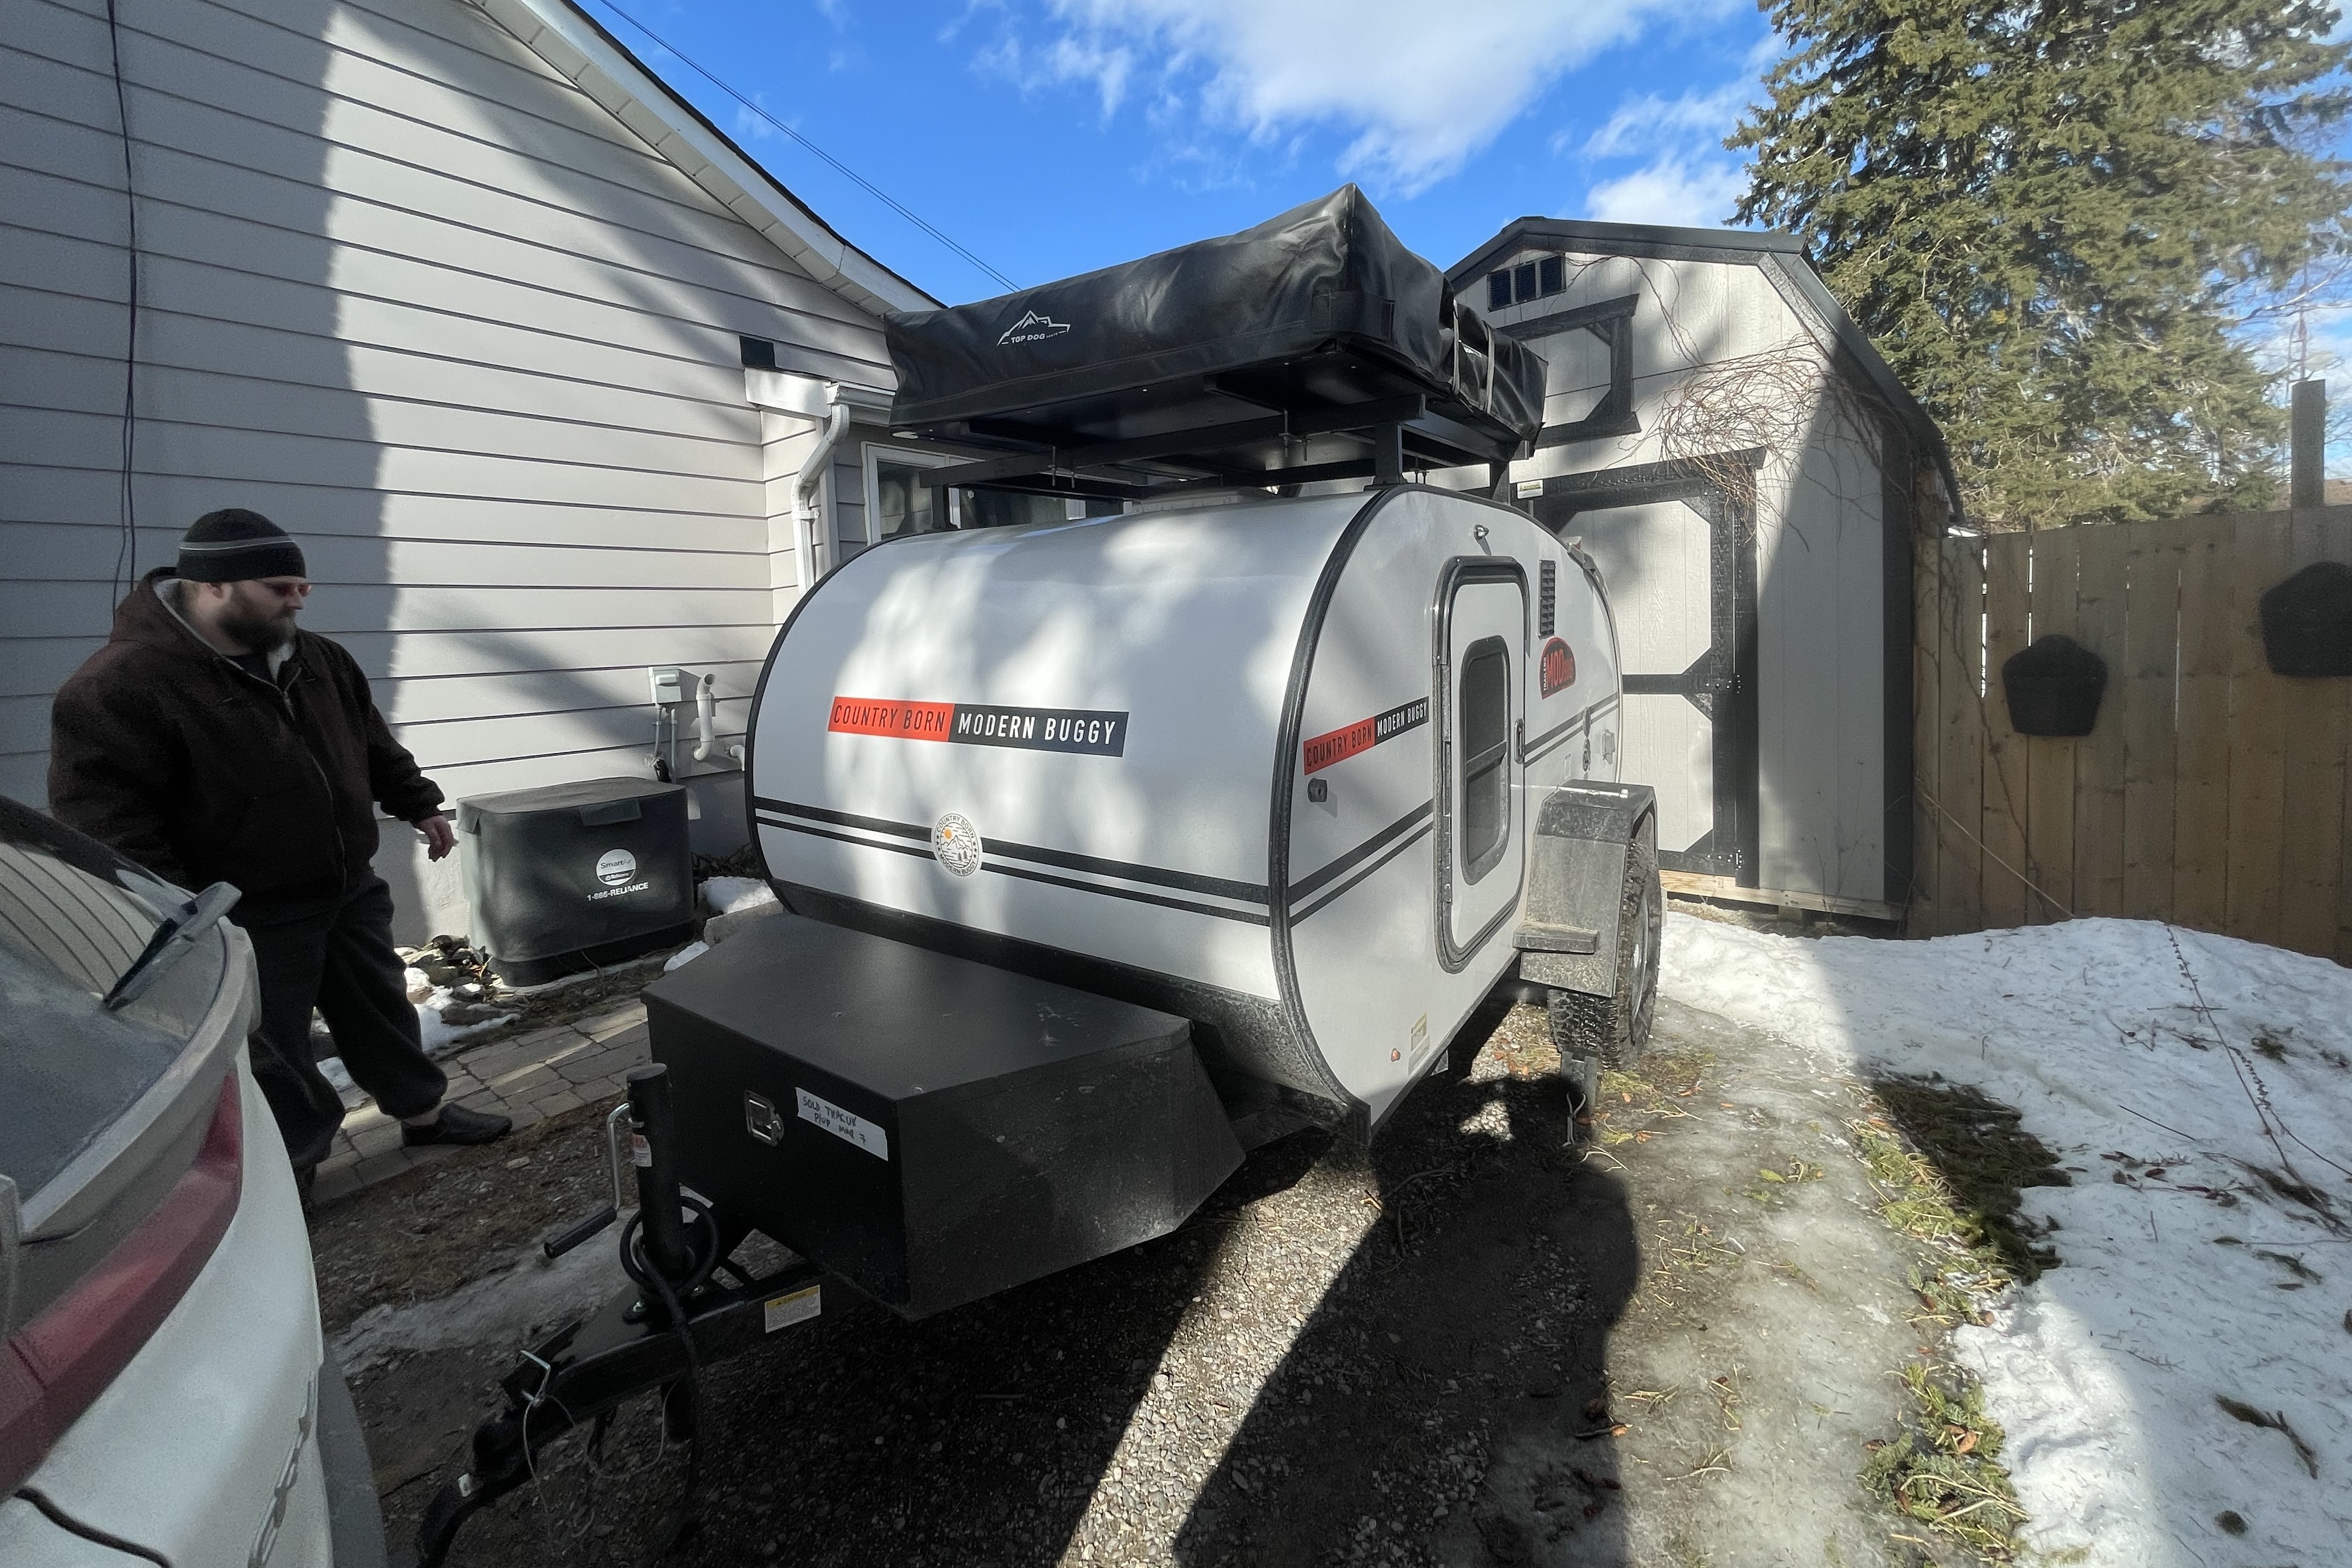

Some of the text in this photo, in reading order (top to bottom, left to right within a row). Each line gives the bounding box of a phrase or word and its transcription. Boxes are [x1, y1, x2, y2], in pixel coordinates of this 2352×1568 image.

[1011, 335, 1026, 344] TOP
[834, 705, 946, 732] COUNTRY BORN
[958, 713, 1116, 745] MODERN BUGGY
[1377, 702, 1427, 737] MODERN BUGGY
[1307, 724, 1372, 767] COUNTRY BORN
[937, 816, 975, 839] COUNTRY BORN
[940, 853, 975, 874] MODERN BUGGY
[802, 1096, 820, 1112] SOLD
